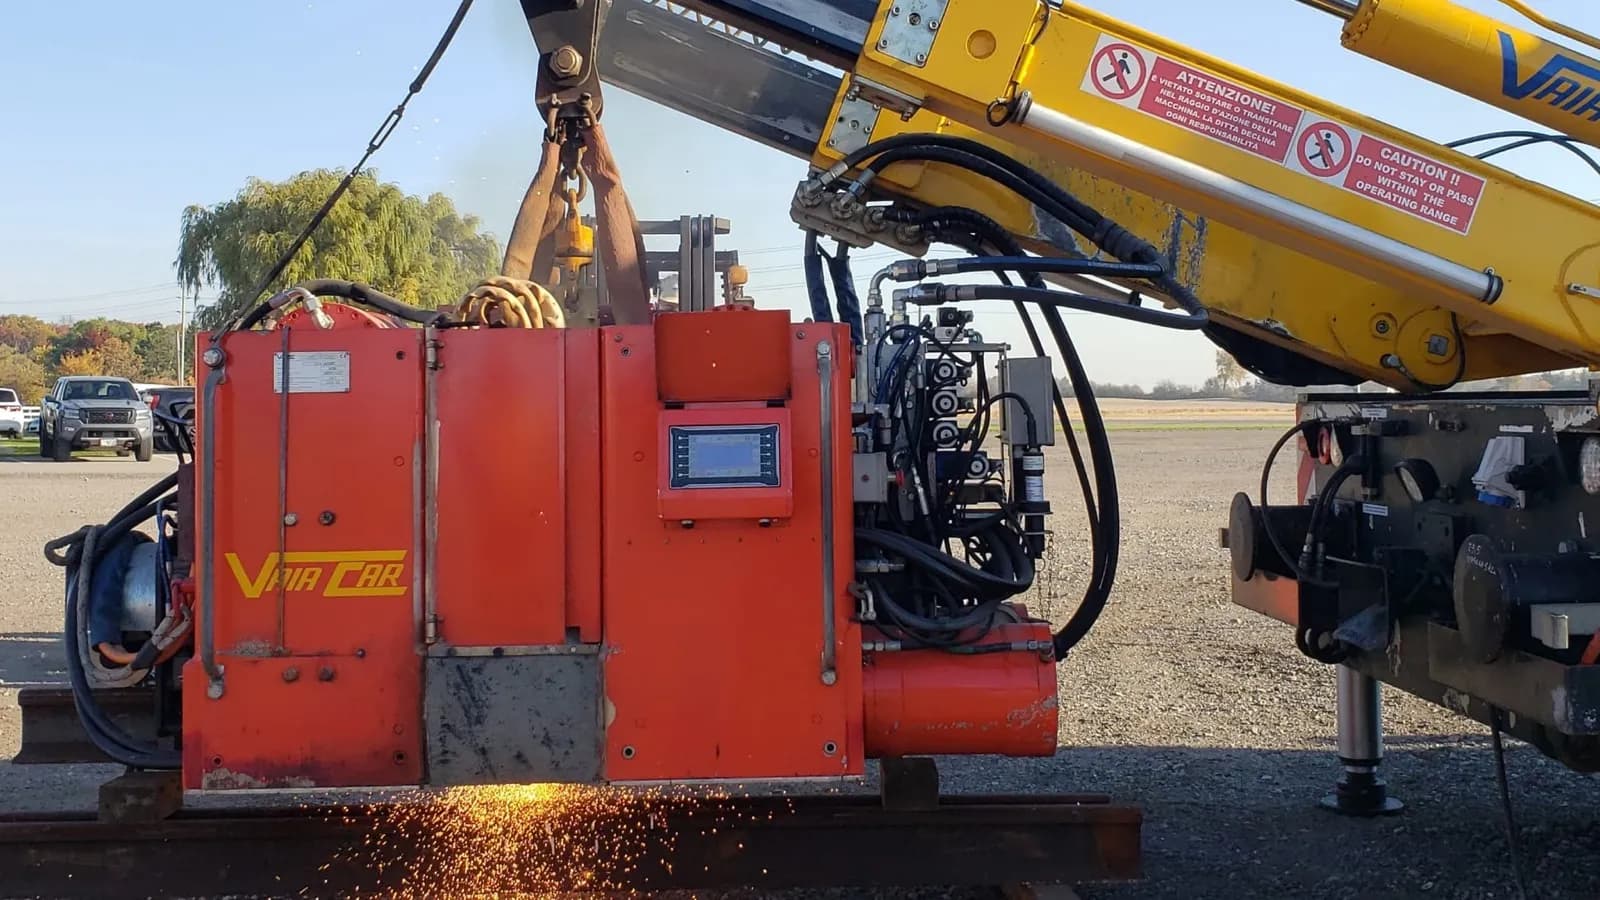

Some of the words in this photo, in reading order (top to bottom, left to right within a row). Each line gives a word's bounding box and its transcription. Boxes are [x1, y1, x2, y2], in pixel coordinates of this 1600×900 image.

[1159, 77, 1194, 95] VIETATO
[1194, 91, 1233, 110] SOSTARE
[1233, 104, 1241, 113] O
[1242, 109, 1294, 134] TRANSITARE
[1159, 88, 1176, 100] NEL
[1178, 95, 1210, 112] RAGGIO
[1211, 107, 1251, 127] D'AZIONE
[1251, 121, 1278, 138] DELLA
[1176, 70, 1277, 116] ATTENZIONE!
[1165, 111, 1188, 124] OGNI
[1202, 114, 1213, 124] LA
[1215, 118, 1239, 133] DITTA
[1241, 127, 1276, 147] DECLINA
[1355, 154, 1372, 167] DO
[1373, 161, 1398, 176] NOT
[1399, 171, 1427, 187] STAY
[1428, 182, 1445, 195] OR
[1446, 189, 1475, 206] PASS
[1380, 147, 1448, 181] CAUTION
[1450, 173, 1461, 186] !!
[1355, 180, 1418, 211] OPERATING
[1419, 204, 1459, 226] RANGE
[1377, 175, 1418, 197] WITHIN
[1423, 192, 1445, 208] THE
[322, 560, 408, 597] CAR
